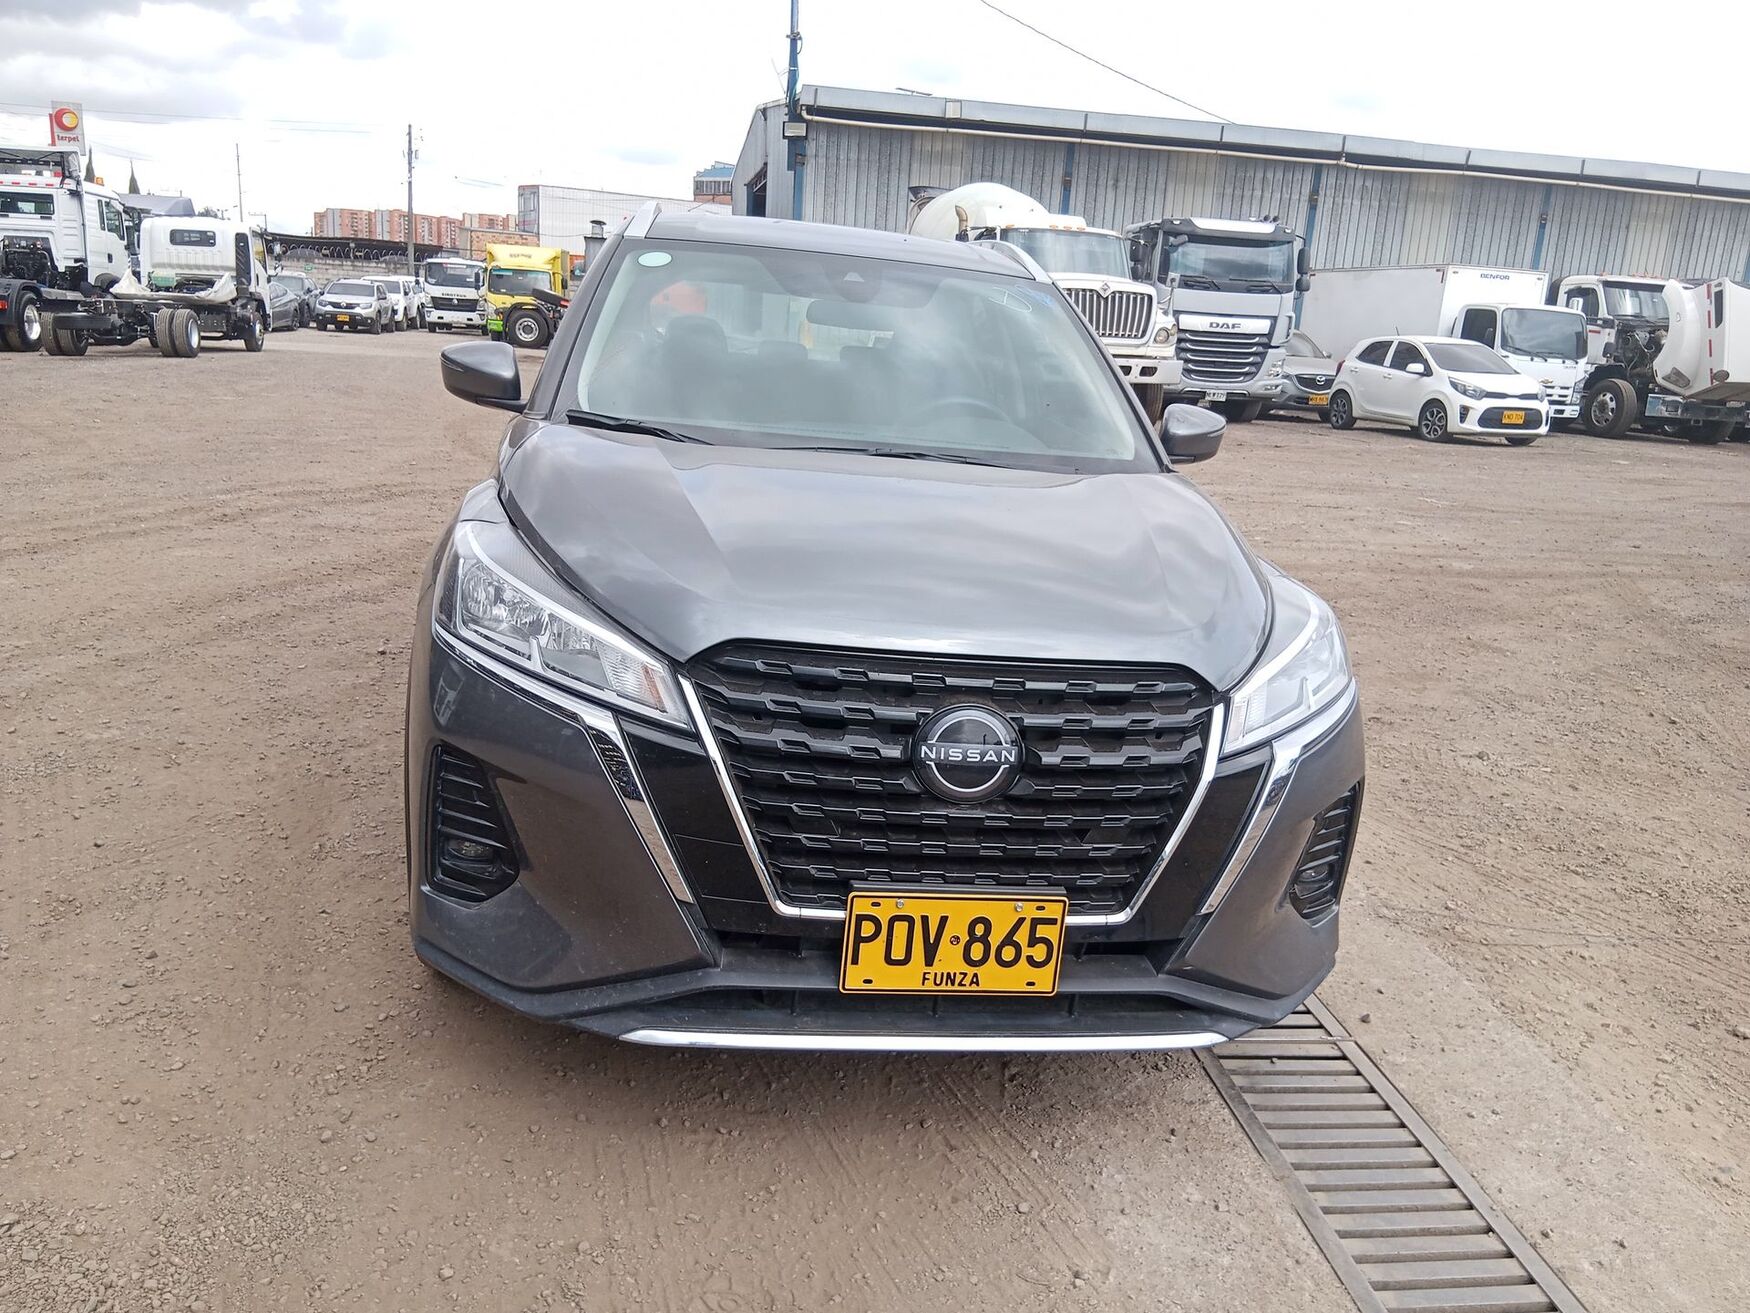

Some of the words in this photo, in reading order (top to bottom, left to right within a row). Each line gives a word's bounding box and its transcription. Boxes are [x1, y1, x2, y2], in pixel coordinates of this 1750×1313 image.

[57, 134, 80, 143] terpel
[1208, 321, 1242, 330] DAF
[920, 744, 1016, 763] NISSAN
[850, 913, 949, 967] POV
[962, 915, 1058, 968] 865
[921, 971, 980, 987] FUNZA
